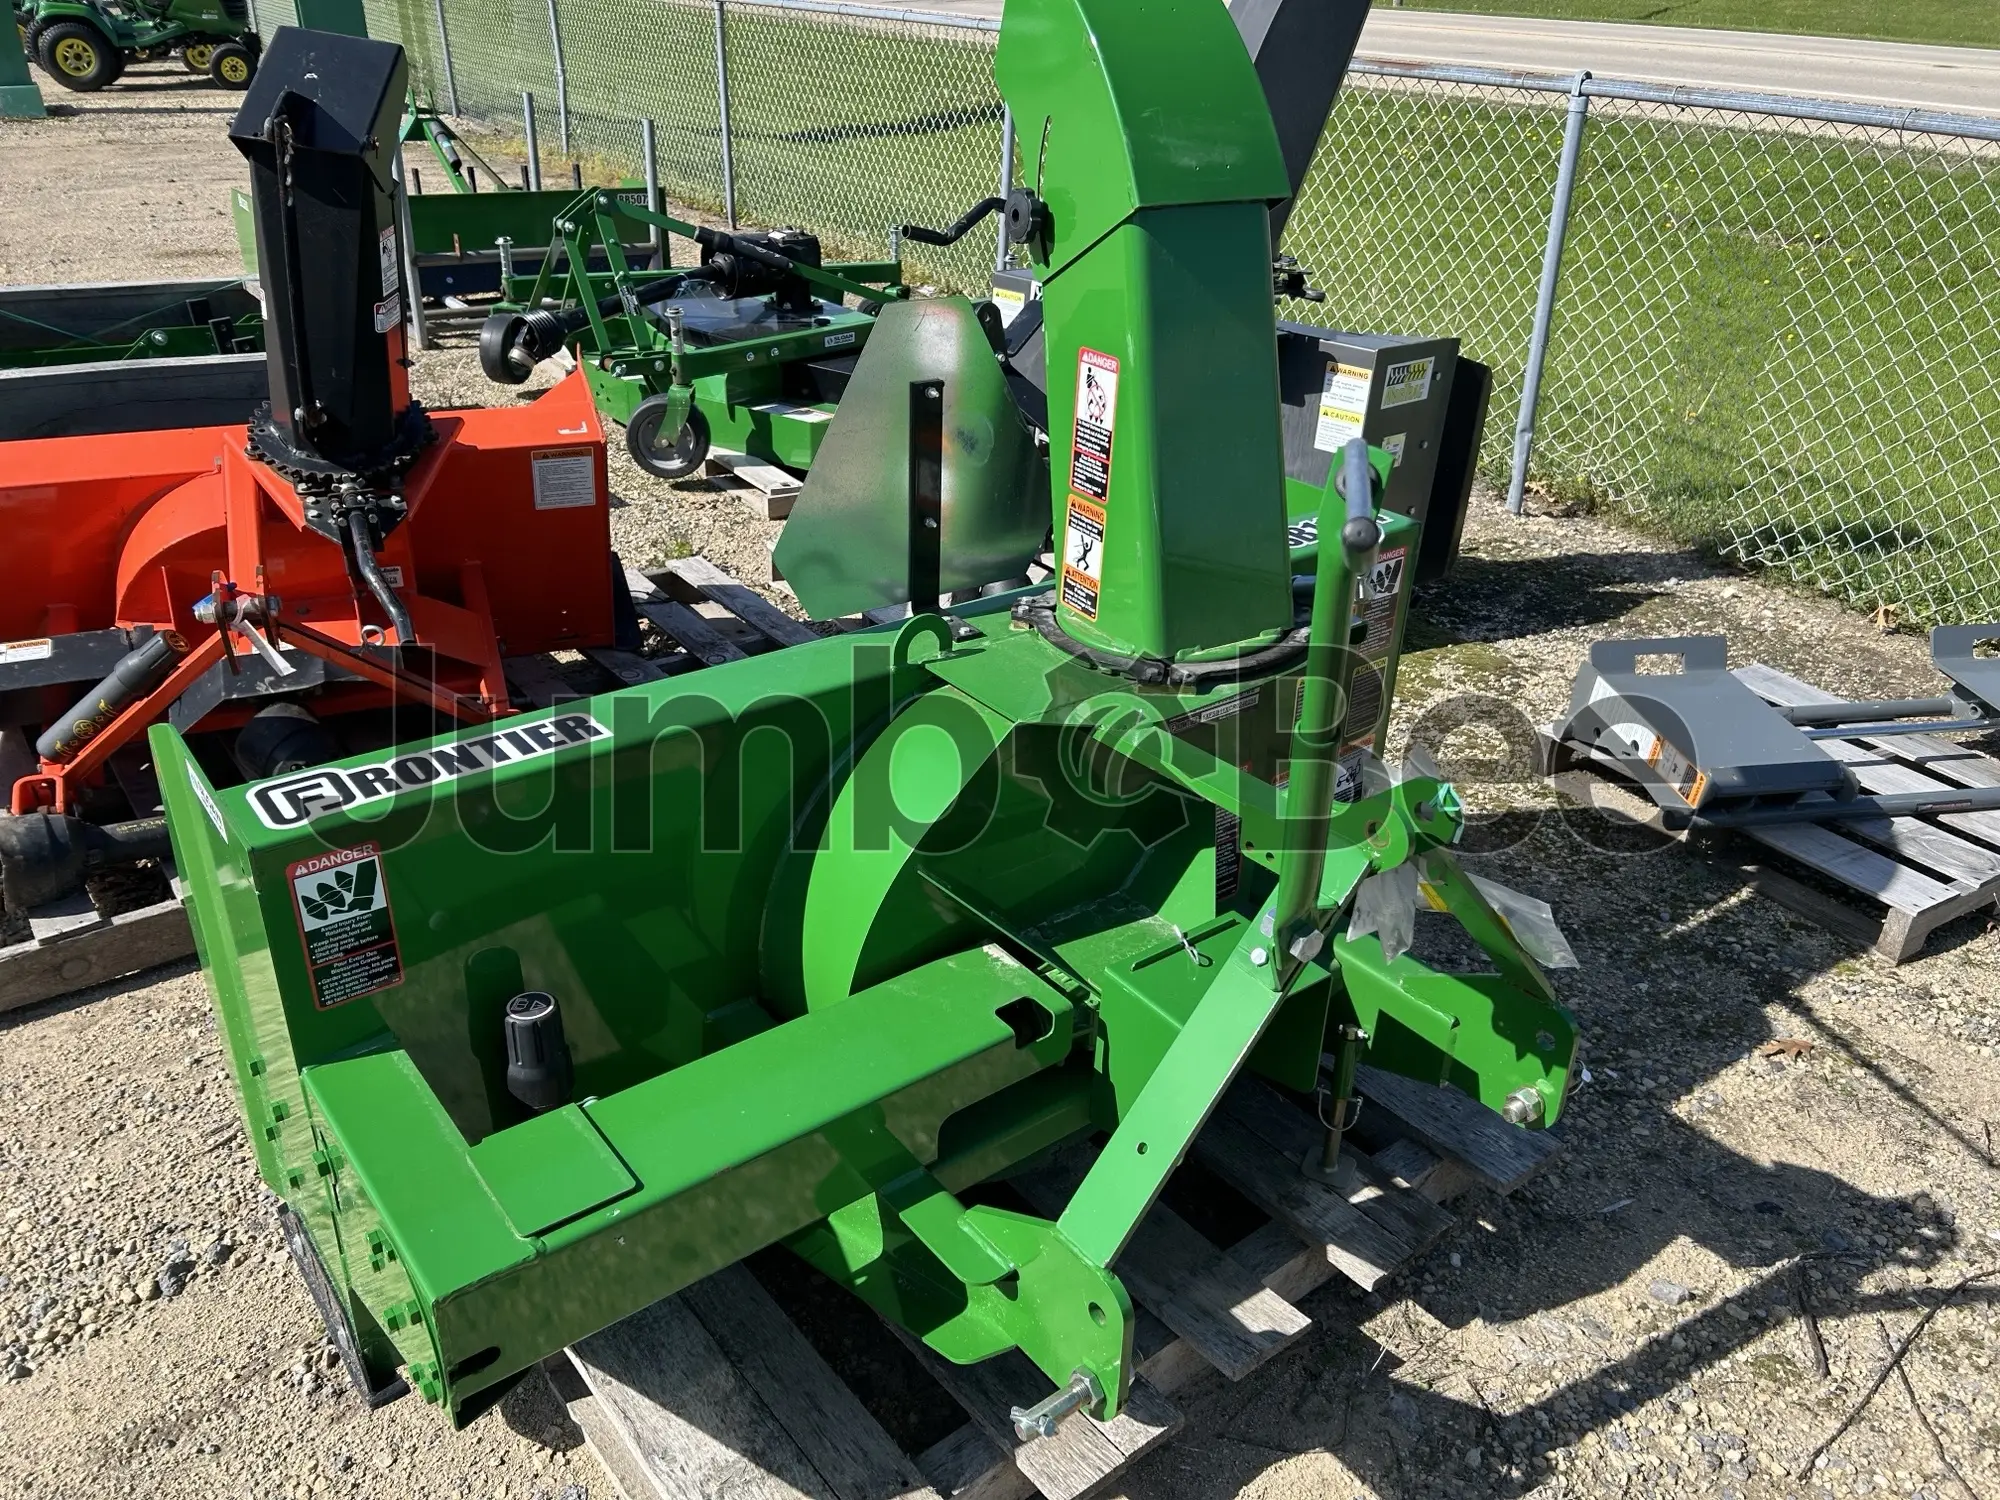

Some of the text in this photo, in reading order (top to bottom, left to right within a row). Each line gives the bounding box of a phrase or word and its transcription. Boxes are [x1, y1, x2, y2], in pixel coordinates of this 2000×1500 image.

[1087, 352, 1117, 371] DANGER
[1336, 367, 1369, 380] WARNING
[1330, 410, 1360, 423] CAUTION
[1076, 501, 1105, 522] WARNING
[1378, 548, 1405, 561] DANGER
[1071, 569, 1098, 590] ATTENTION
[1360, 658, 1387, 673] CAUTION
[254, 714, 604, 826] FRONTIER
[308, 844, 374, 872] DANGER
[320, 912, 372, 932] Avoid Injury From
[325, 925, 350, 937] Rotating
[313, 938, 329, 947] Keep
[314, 941, 338, 953] clothing
[315, 950, 329, 958] Shut
[339, 940, 359, 951] engine
[359, 934, 378, 944] before
[321, 974, 341, 984] Garder
[380, 955, 396, 964] pieds
